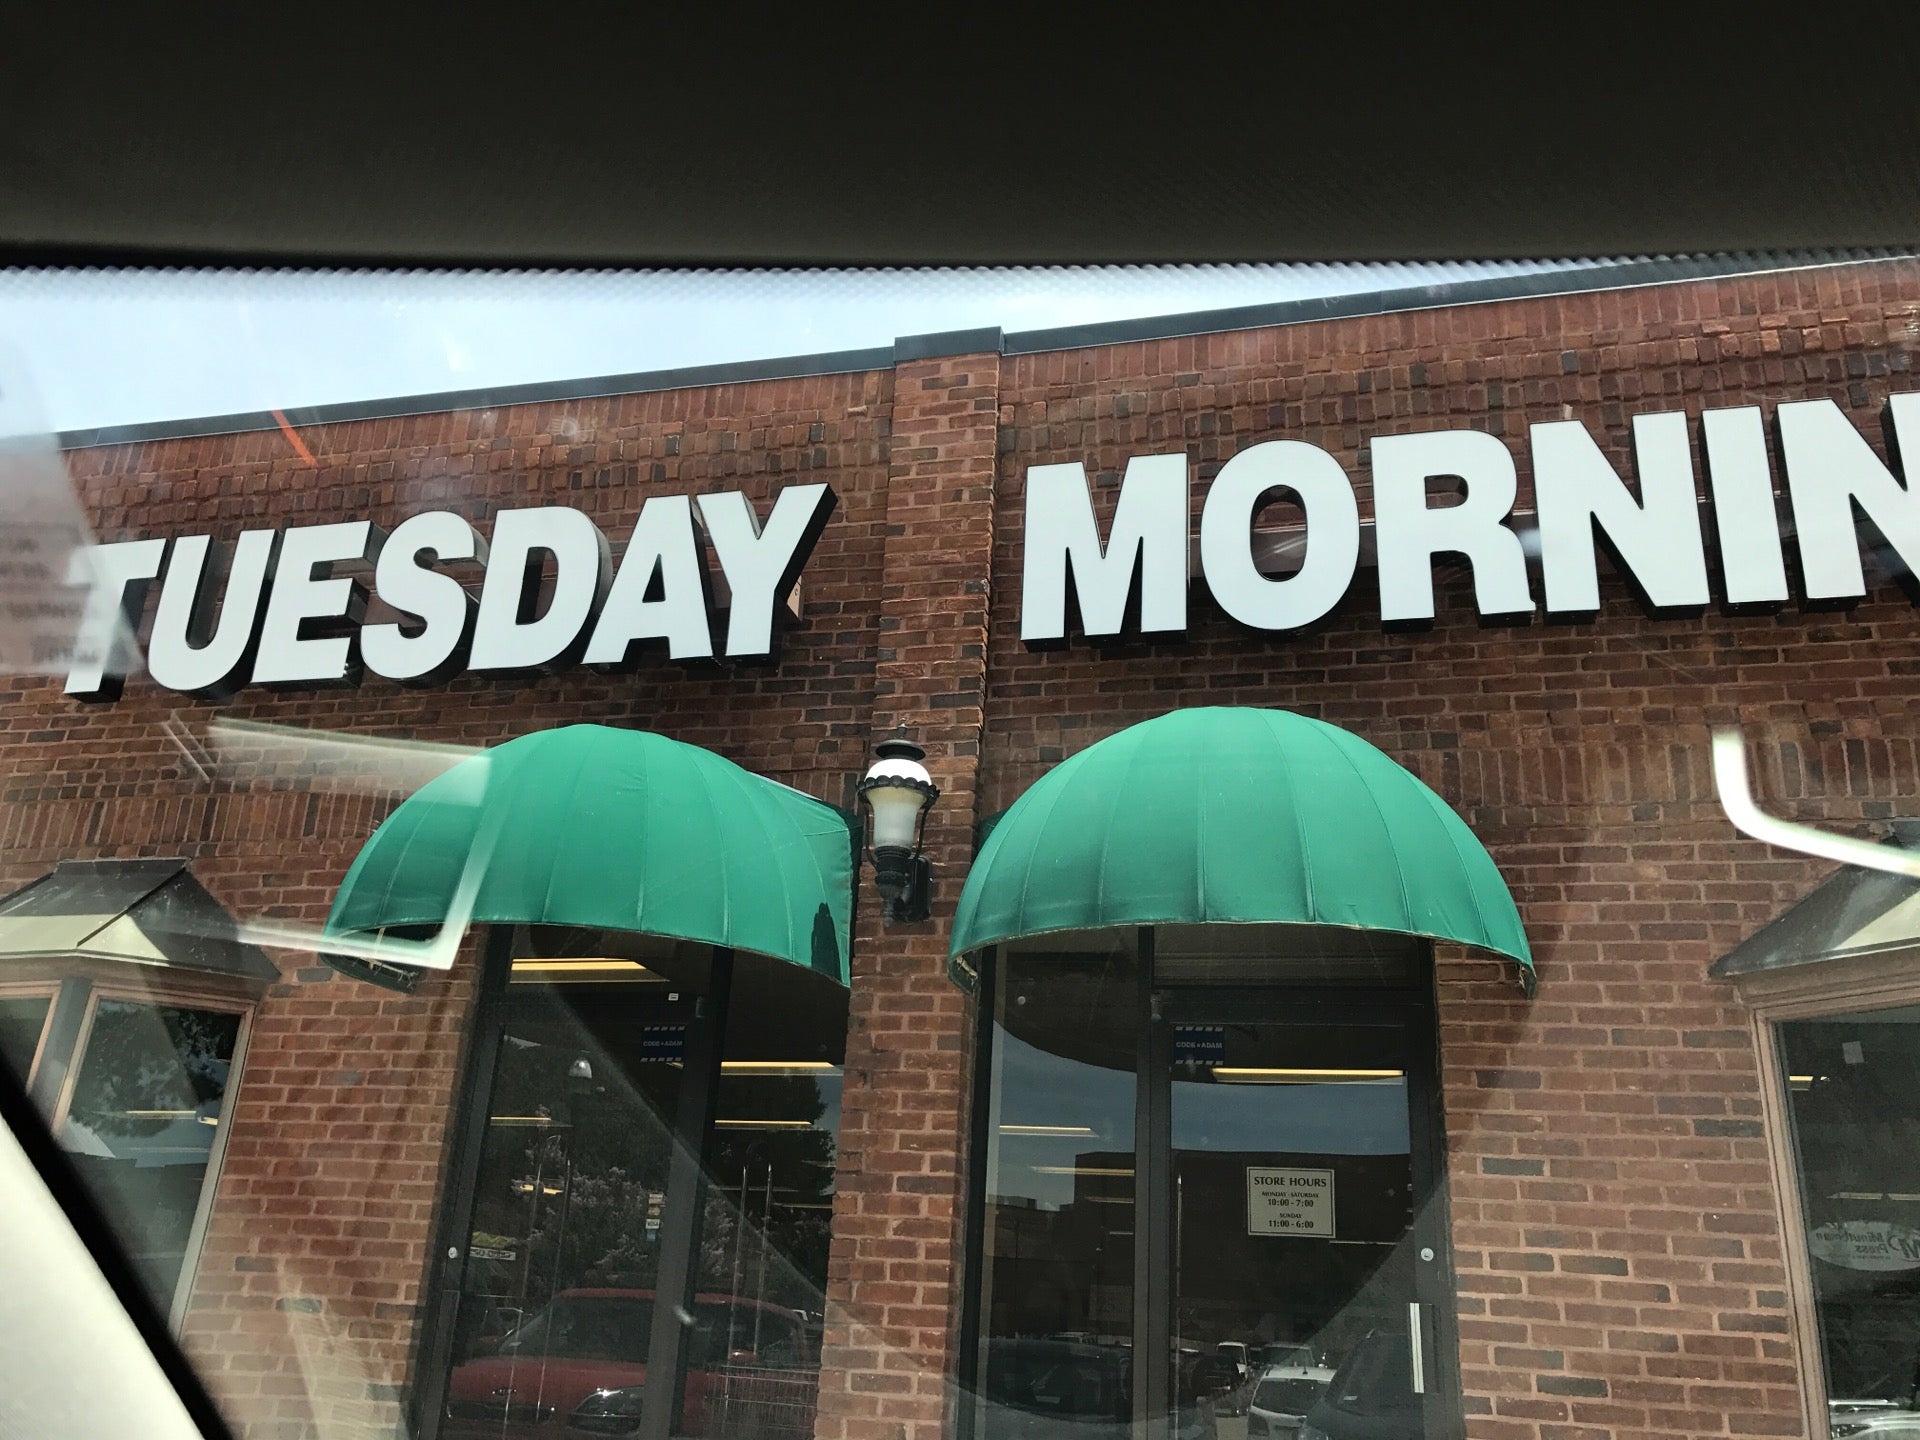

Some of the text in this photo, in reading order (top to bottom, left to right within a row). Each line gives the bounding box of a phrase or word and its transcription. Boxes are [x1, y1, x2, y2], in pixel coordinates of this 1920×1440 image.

[64, 391, 1920, 696] TUESDAY MORNIN
[1254, 1177, 1327, 1187] STORE HOURS
